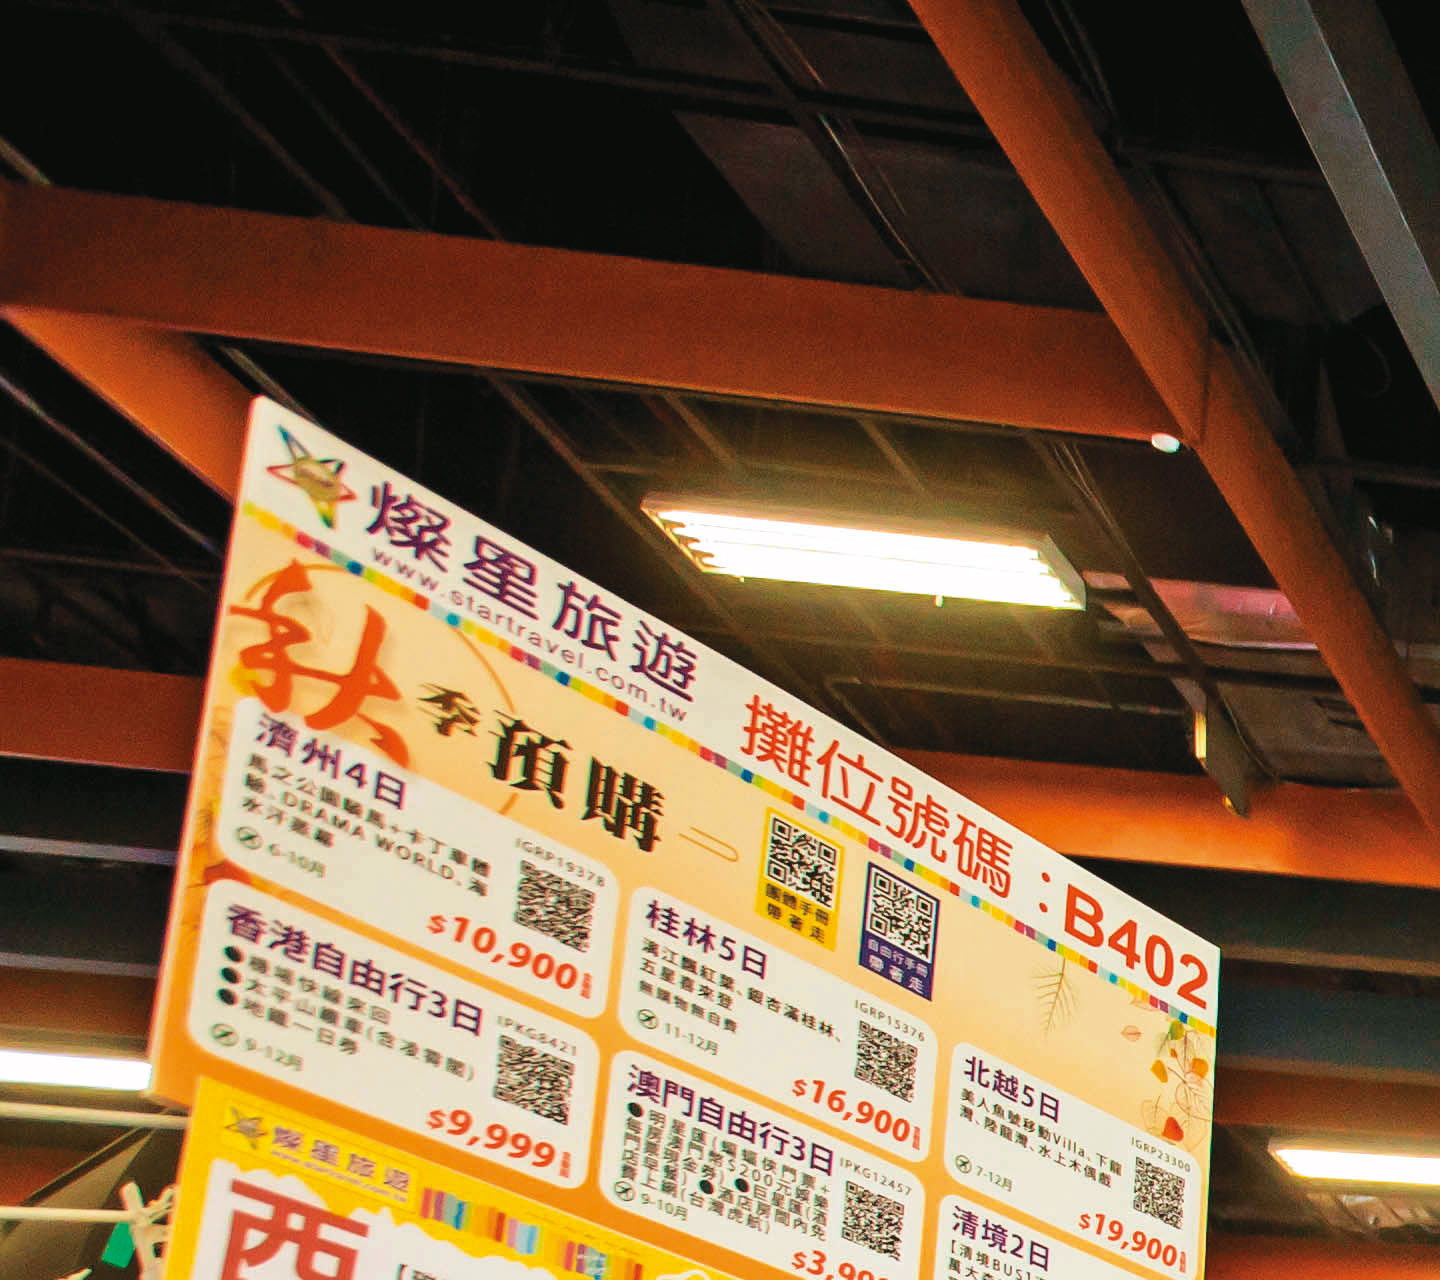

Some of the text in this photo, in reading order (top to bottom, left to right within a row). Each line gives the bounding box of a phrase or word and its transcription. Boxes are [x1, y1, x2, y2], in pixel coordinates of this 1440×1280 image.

[366, 481, 698, 703] 燦星旅遊
[371, 546, 688, 723] www.startravel.com.tw
[255, 713, 408, 810] 濟州4日
[227, 903, 483, 1037] 香港自由行3日
[427, 912, 579, 991] $10,900
[645, 900, 768, 980] 桂林5日
[627, 1063, 835, 1178] 澳門自由行3日
[791, 1077, 911, 1143] $16,900
[964, 1056, 1061, 1123] 北越5日
[426, 1105, 559, 1172] $9,999
[952, 1205, 1050, 1272] 清境2日
[1078, 1211, 1178, 1267] $19,900
